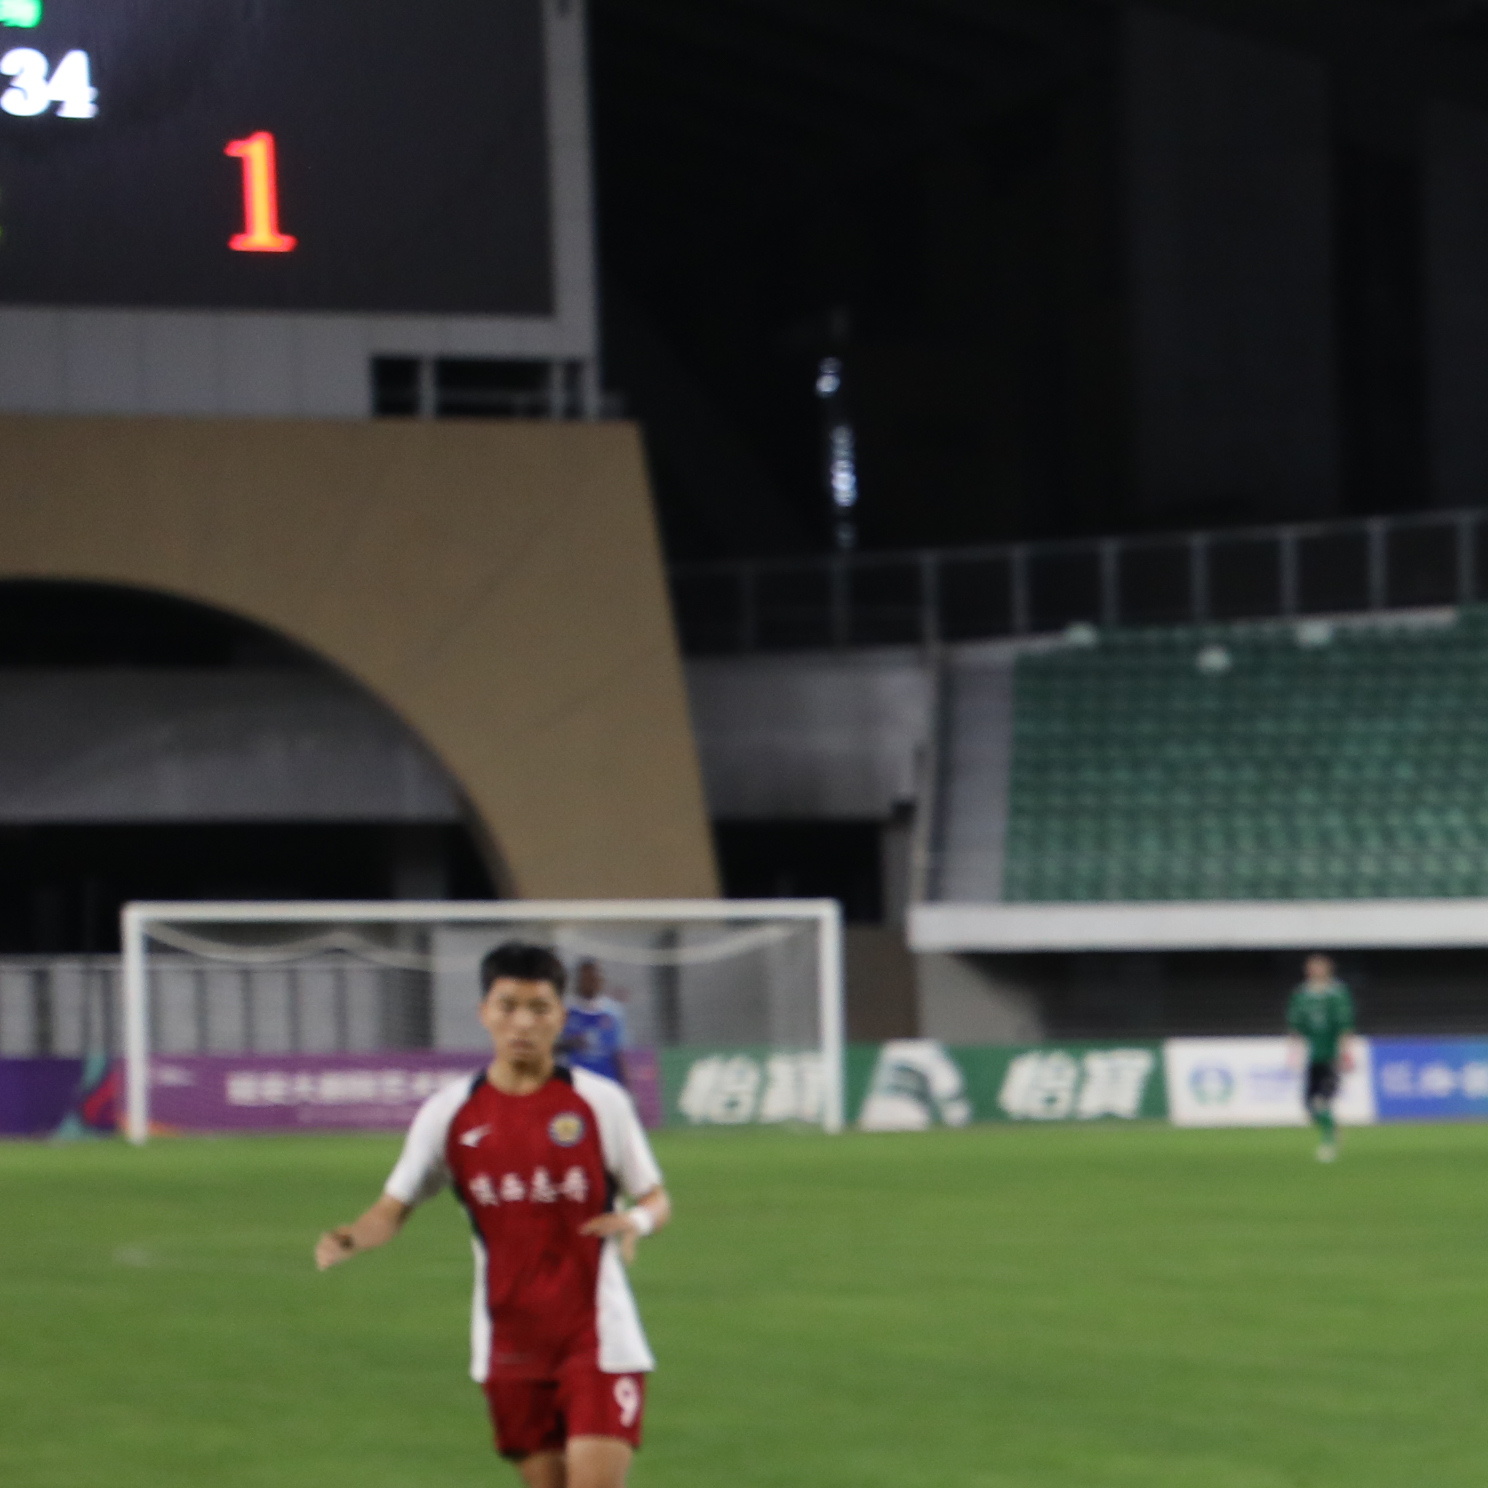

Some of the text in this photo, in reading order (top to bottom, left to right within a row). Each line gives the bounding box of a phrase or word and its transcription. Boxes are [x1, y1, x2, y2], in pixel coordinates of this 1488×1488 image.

[0, 47, 99, 119] 34
[224, 130, 298, 253] 1
[613, 1376, 640, 1429] 9
